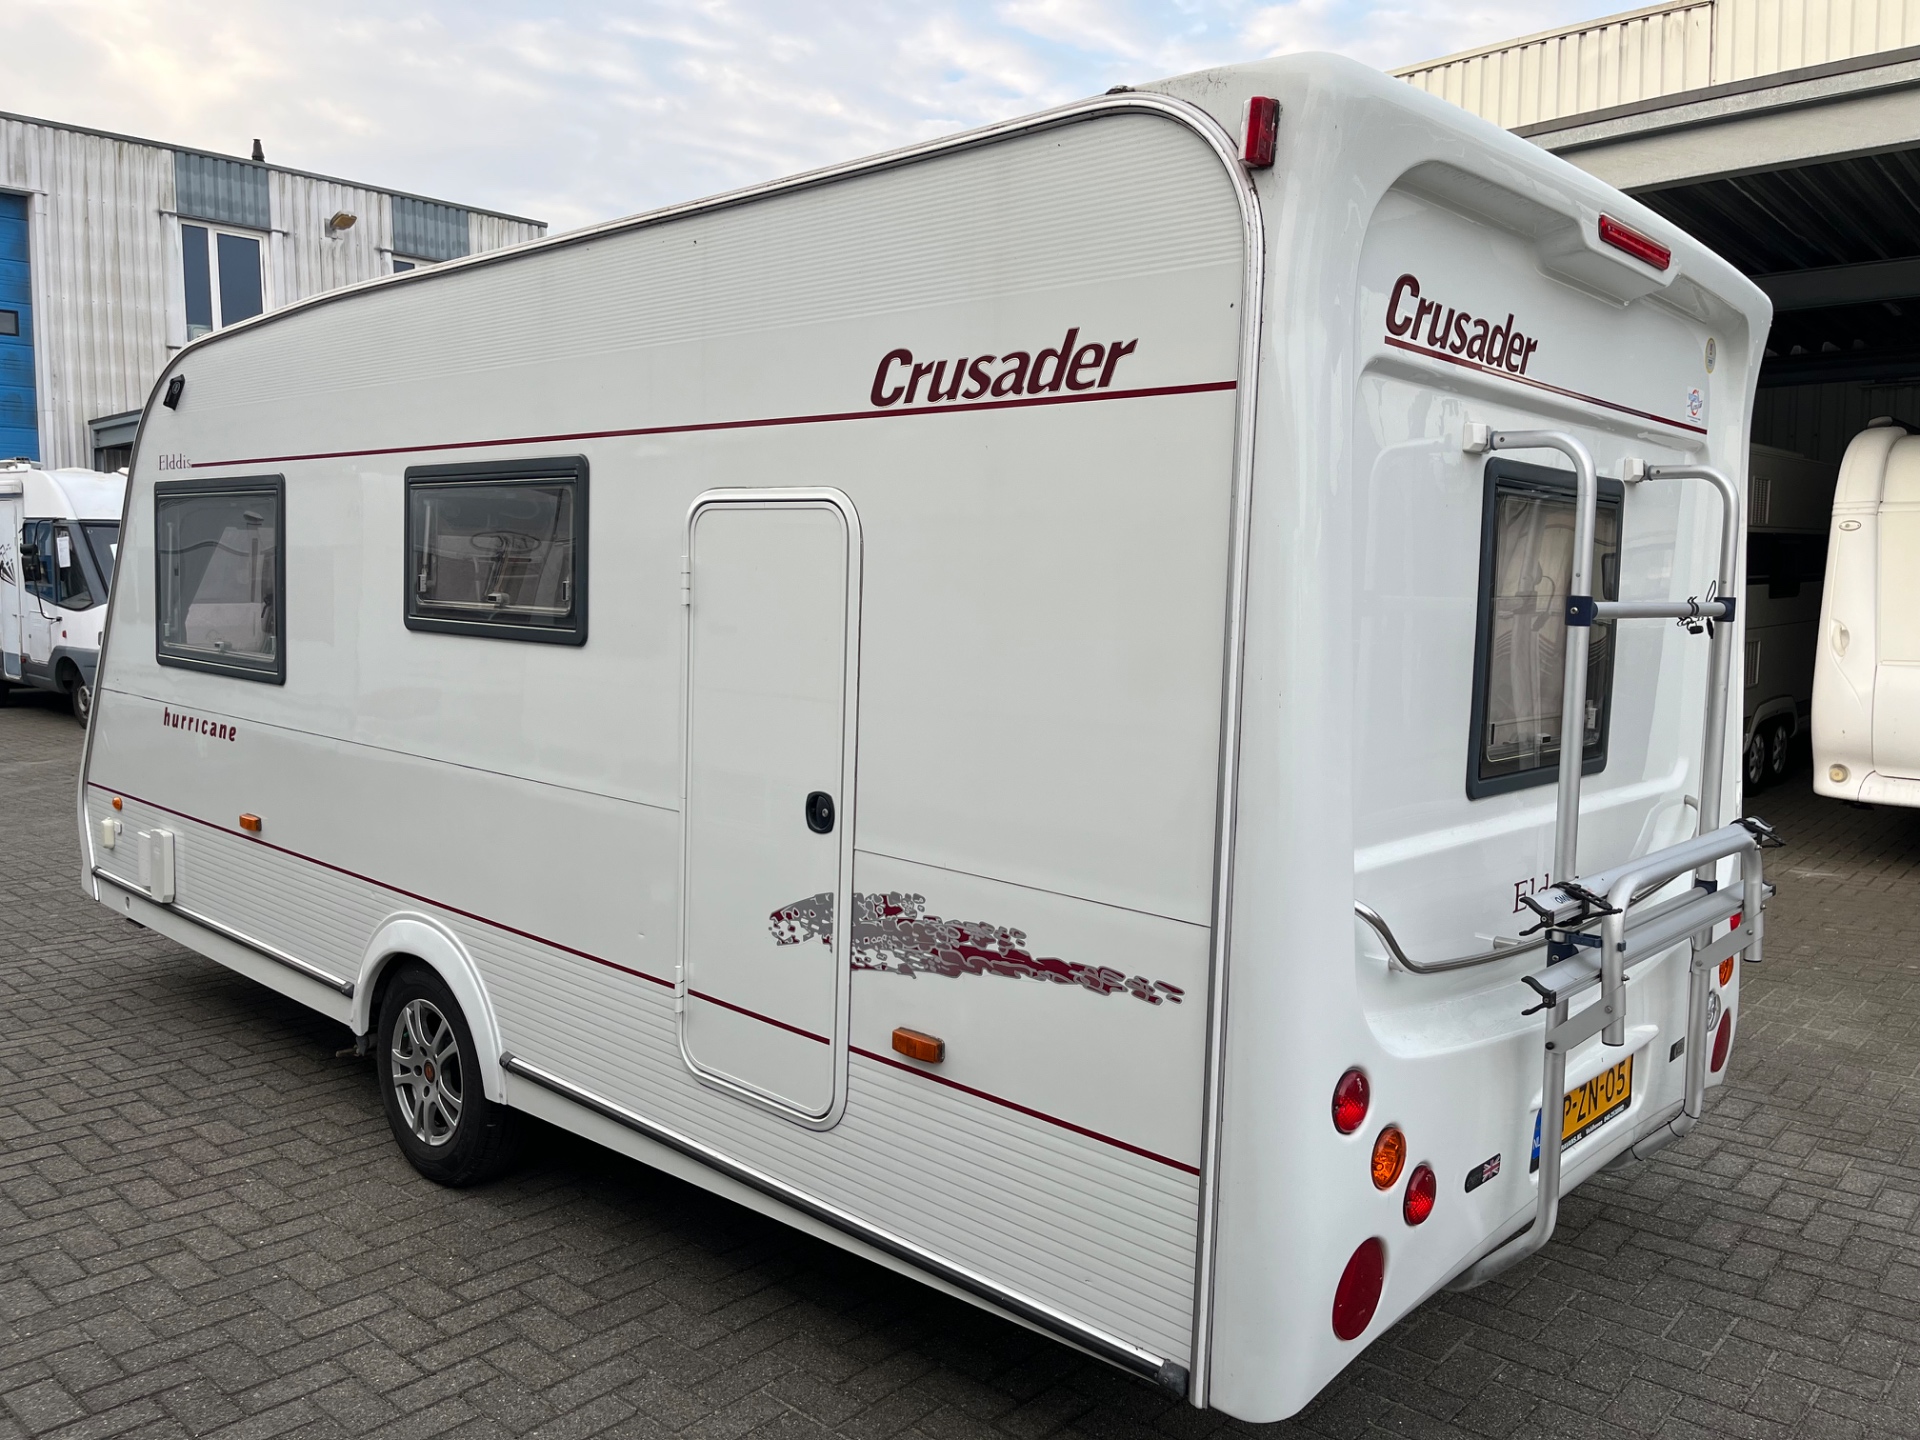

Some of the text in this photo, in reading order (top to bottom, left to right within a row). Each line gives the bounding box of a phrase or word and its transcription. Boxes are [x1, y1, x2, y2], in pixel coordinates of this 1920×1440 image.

[1386, 273, 1538, 375] Crusader
[870, 327, 1138, 407] Crusader
[159, 453, 191, 471] Elddis
[163, 706, 237, 742] hurricane
